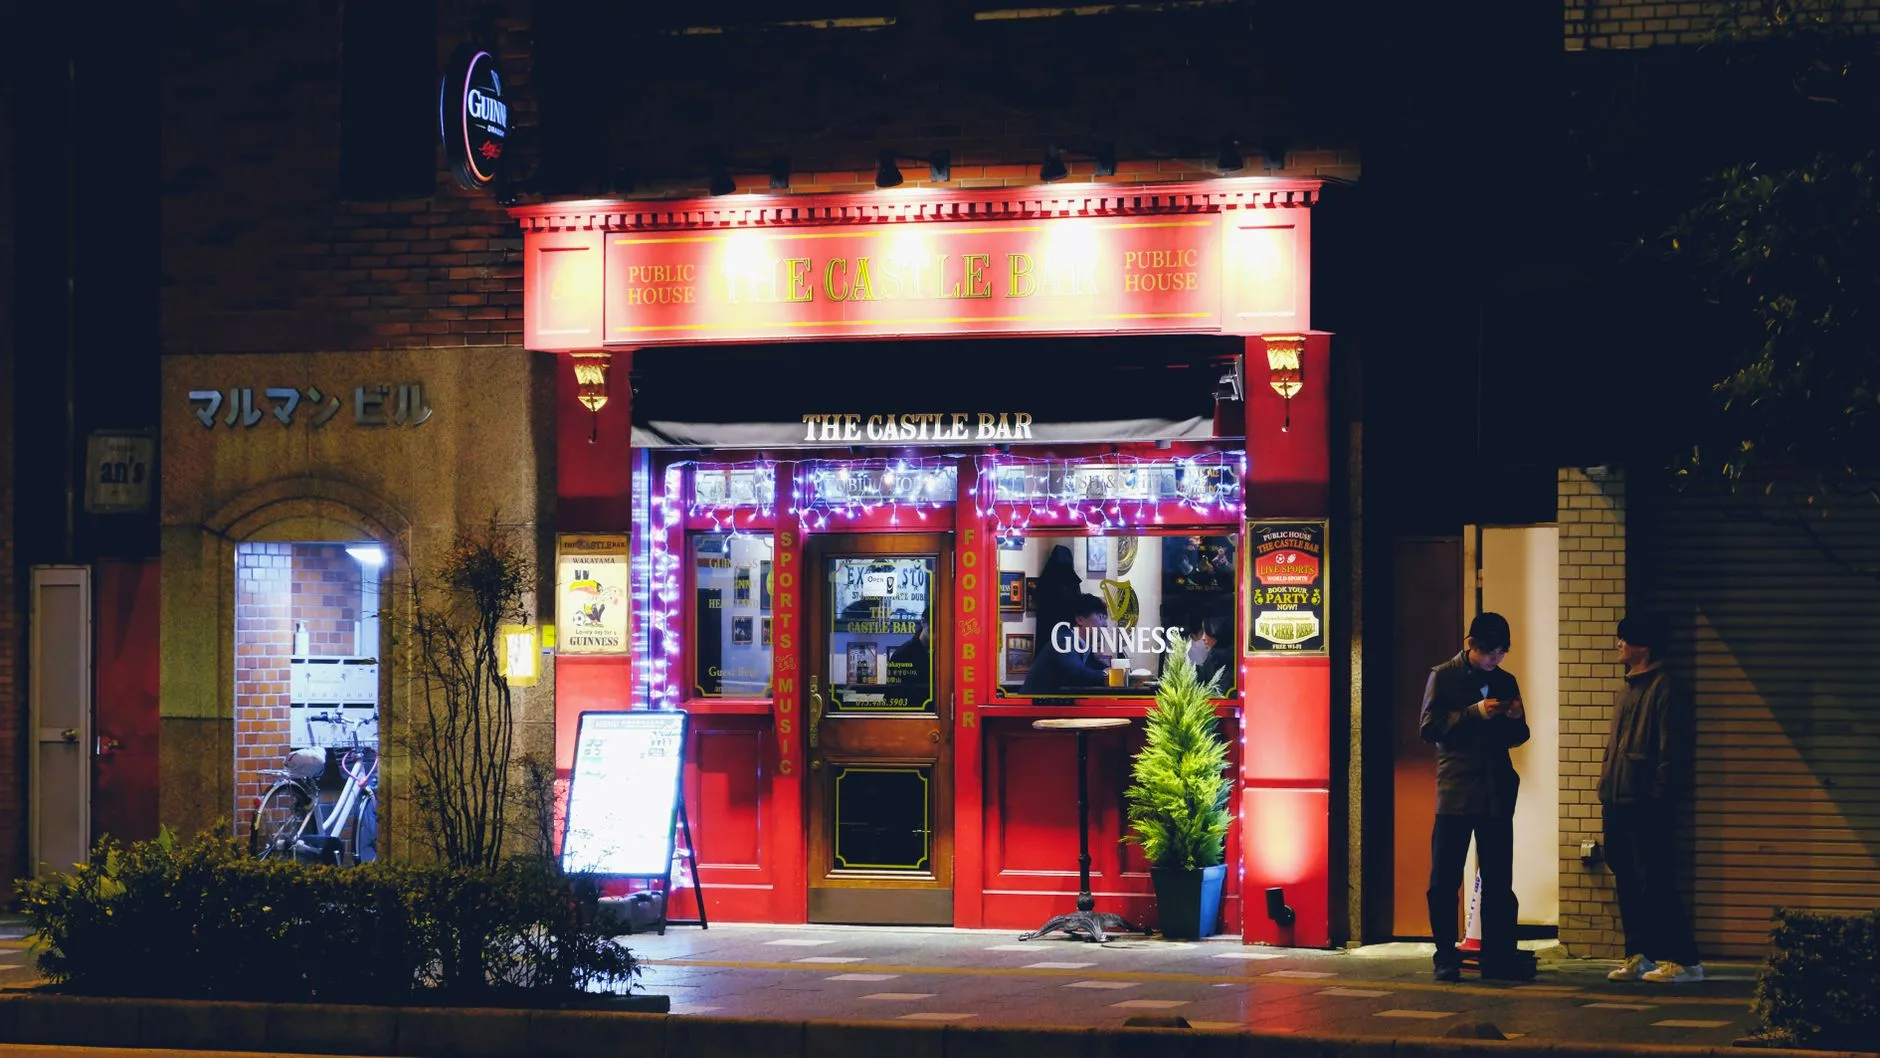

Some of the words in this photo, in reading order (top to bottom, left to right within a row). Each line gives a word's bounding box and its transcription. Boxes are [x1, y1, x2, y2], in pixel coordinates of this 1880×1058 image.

[468, 89, 507, 128] GUINN
[1124, 248, 1198, 270] PUBLIC
[628, 264, 696, 283] PUBLIC
[825, 253, 991, 302] CASTLE
[1124, 273, 1199, 292] HOUSE
[628, 287, 696, 305] HOUSE
[802, 413, 862, 441] THE
[867, 412, 969, 441] CASTLE
[976, 412, 1033, 440] BAR
[1257, 542, 1275, 553] THE
[1275, 539, 1305, 549] CASTLE
[1305, 542, 1319, 553] BAR
[1263, 531, 1288, 541] PUBLIC
[1289, 531, 1312, 541] HOUSE
[962, 529, 976, 613] FOOD
[1260, 564, 1280, 576] LIVE
[1281, 564, 1314, 575] SPORTS
[779, 532, 793, 649] SPORTS
[1265, 593, 1309, 604] PARTY
[847, 622, 890, 633] CASTLE
[892, 622, 916, 633] BAR
[1051, 621, 1182, 654] GUINNESS
[570, 636, 619, 646] GUINNESS
[962, 643, 976, 728] BEER
[778, 678, 793, 775] MUSIC
